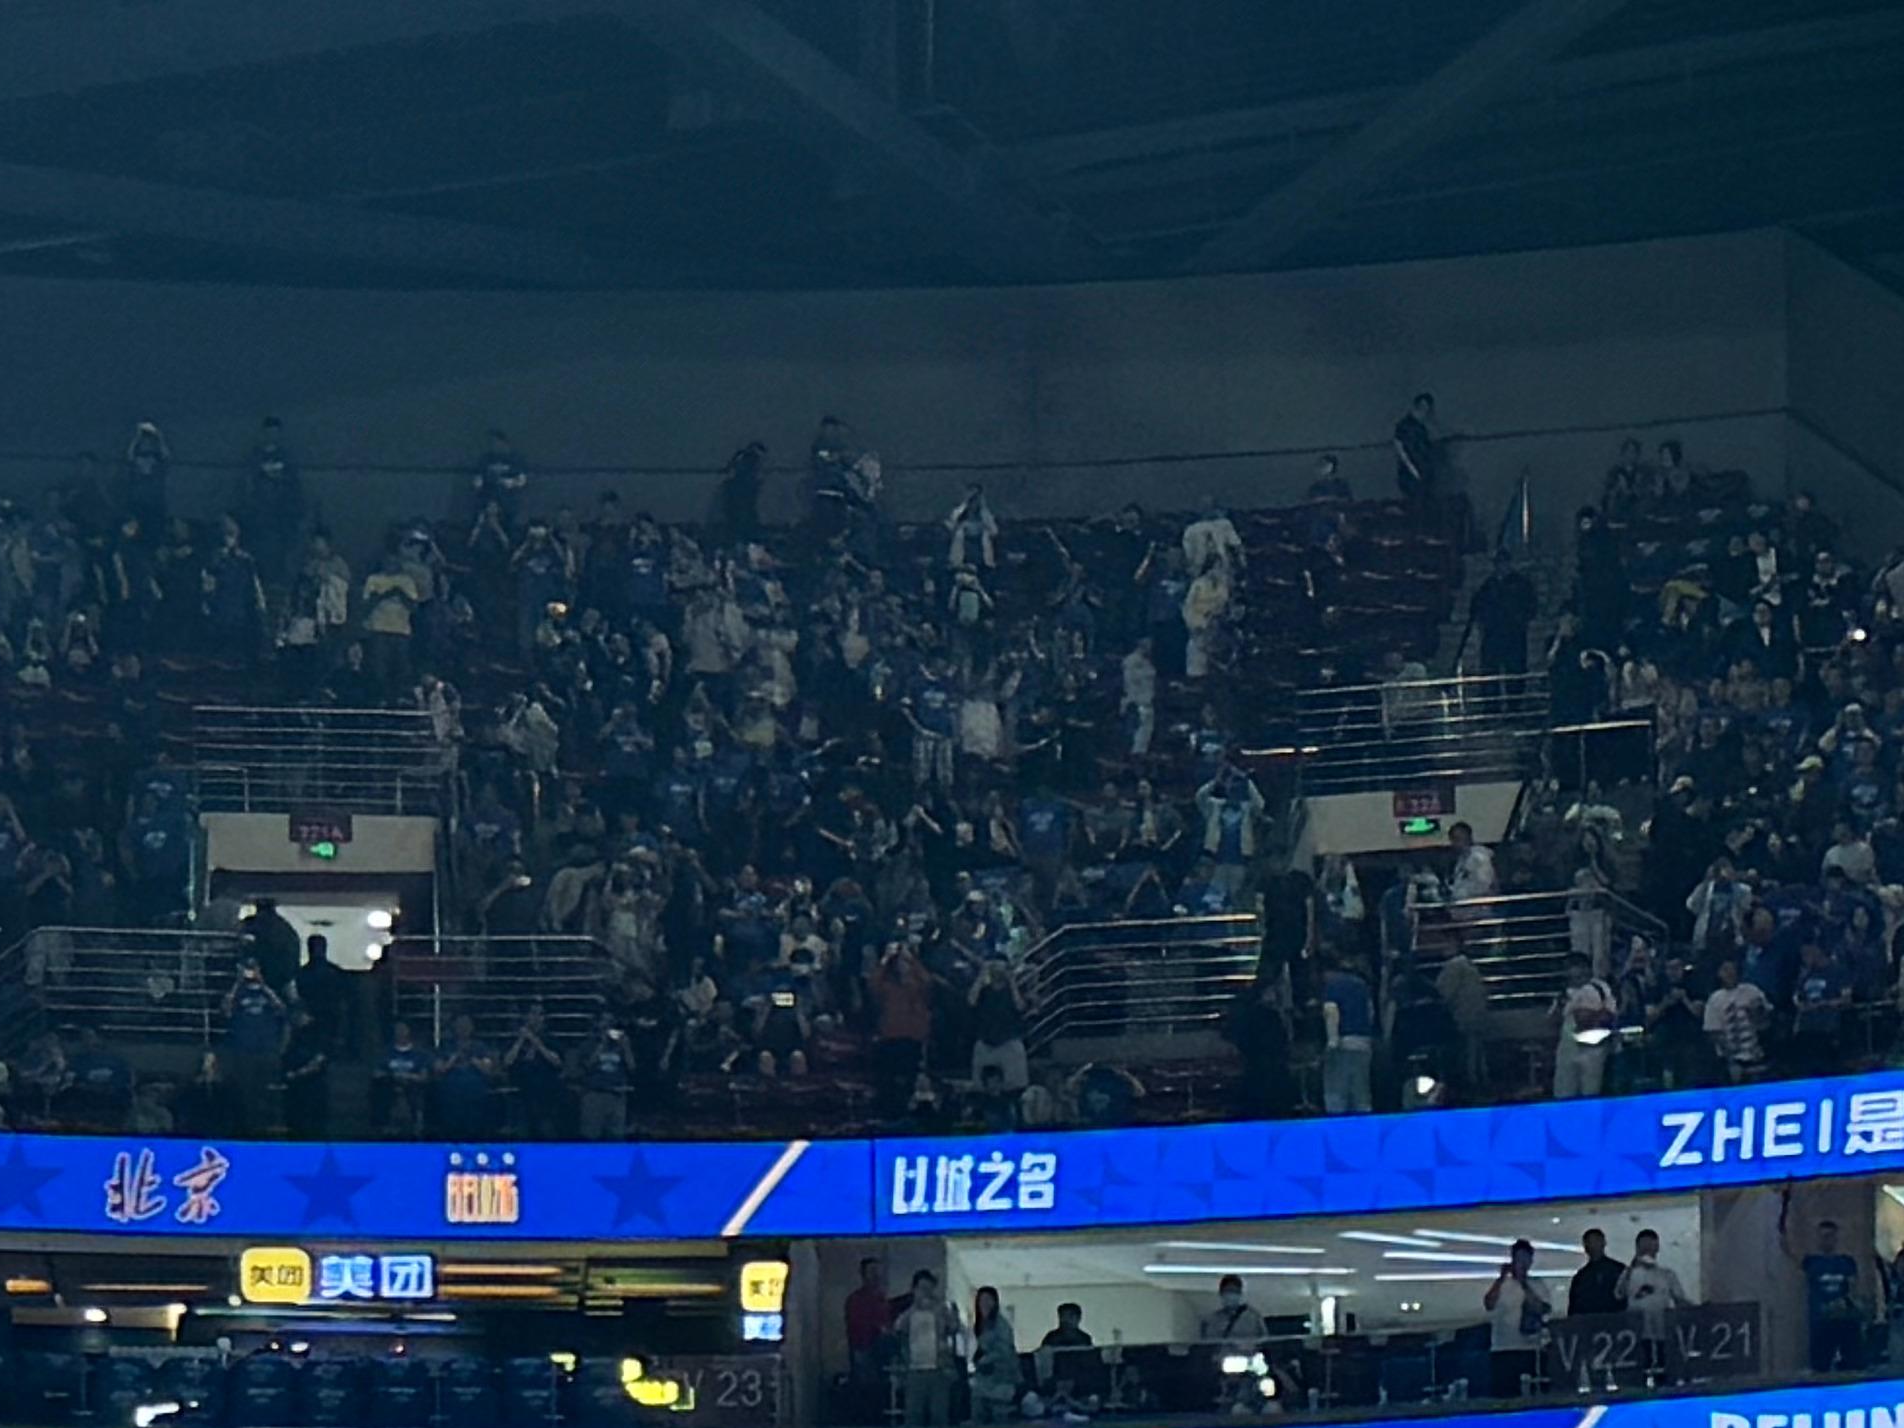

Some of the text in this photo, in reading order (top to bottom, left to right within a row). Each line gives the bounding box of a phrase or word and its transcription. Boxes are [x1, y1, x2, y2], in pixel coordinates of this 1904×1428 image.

[105, 1146, 230, 1225] 北京
[891, 1150, 1058, 1217] 以城之名
[318, 1254, 434, 1300] 美团
[1555, 1331, 1638, 1373] V 22
[1710, 1323, 1753, 1361] 21
[716, 1370, 763, 1407] 23
